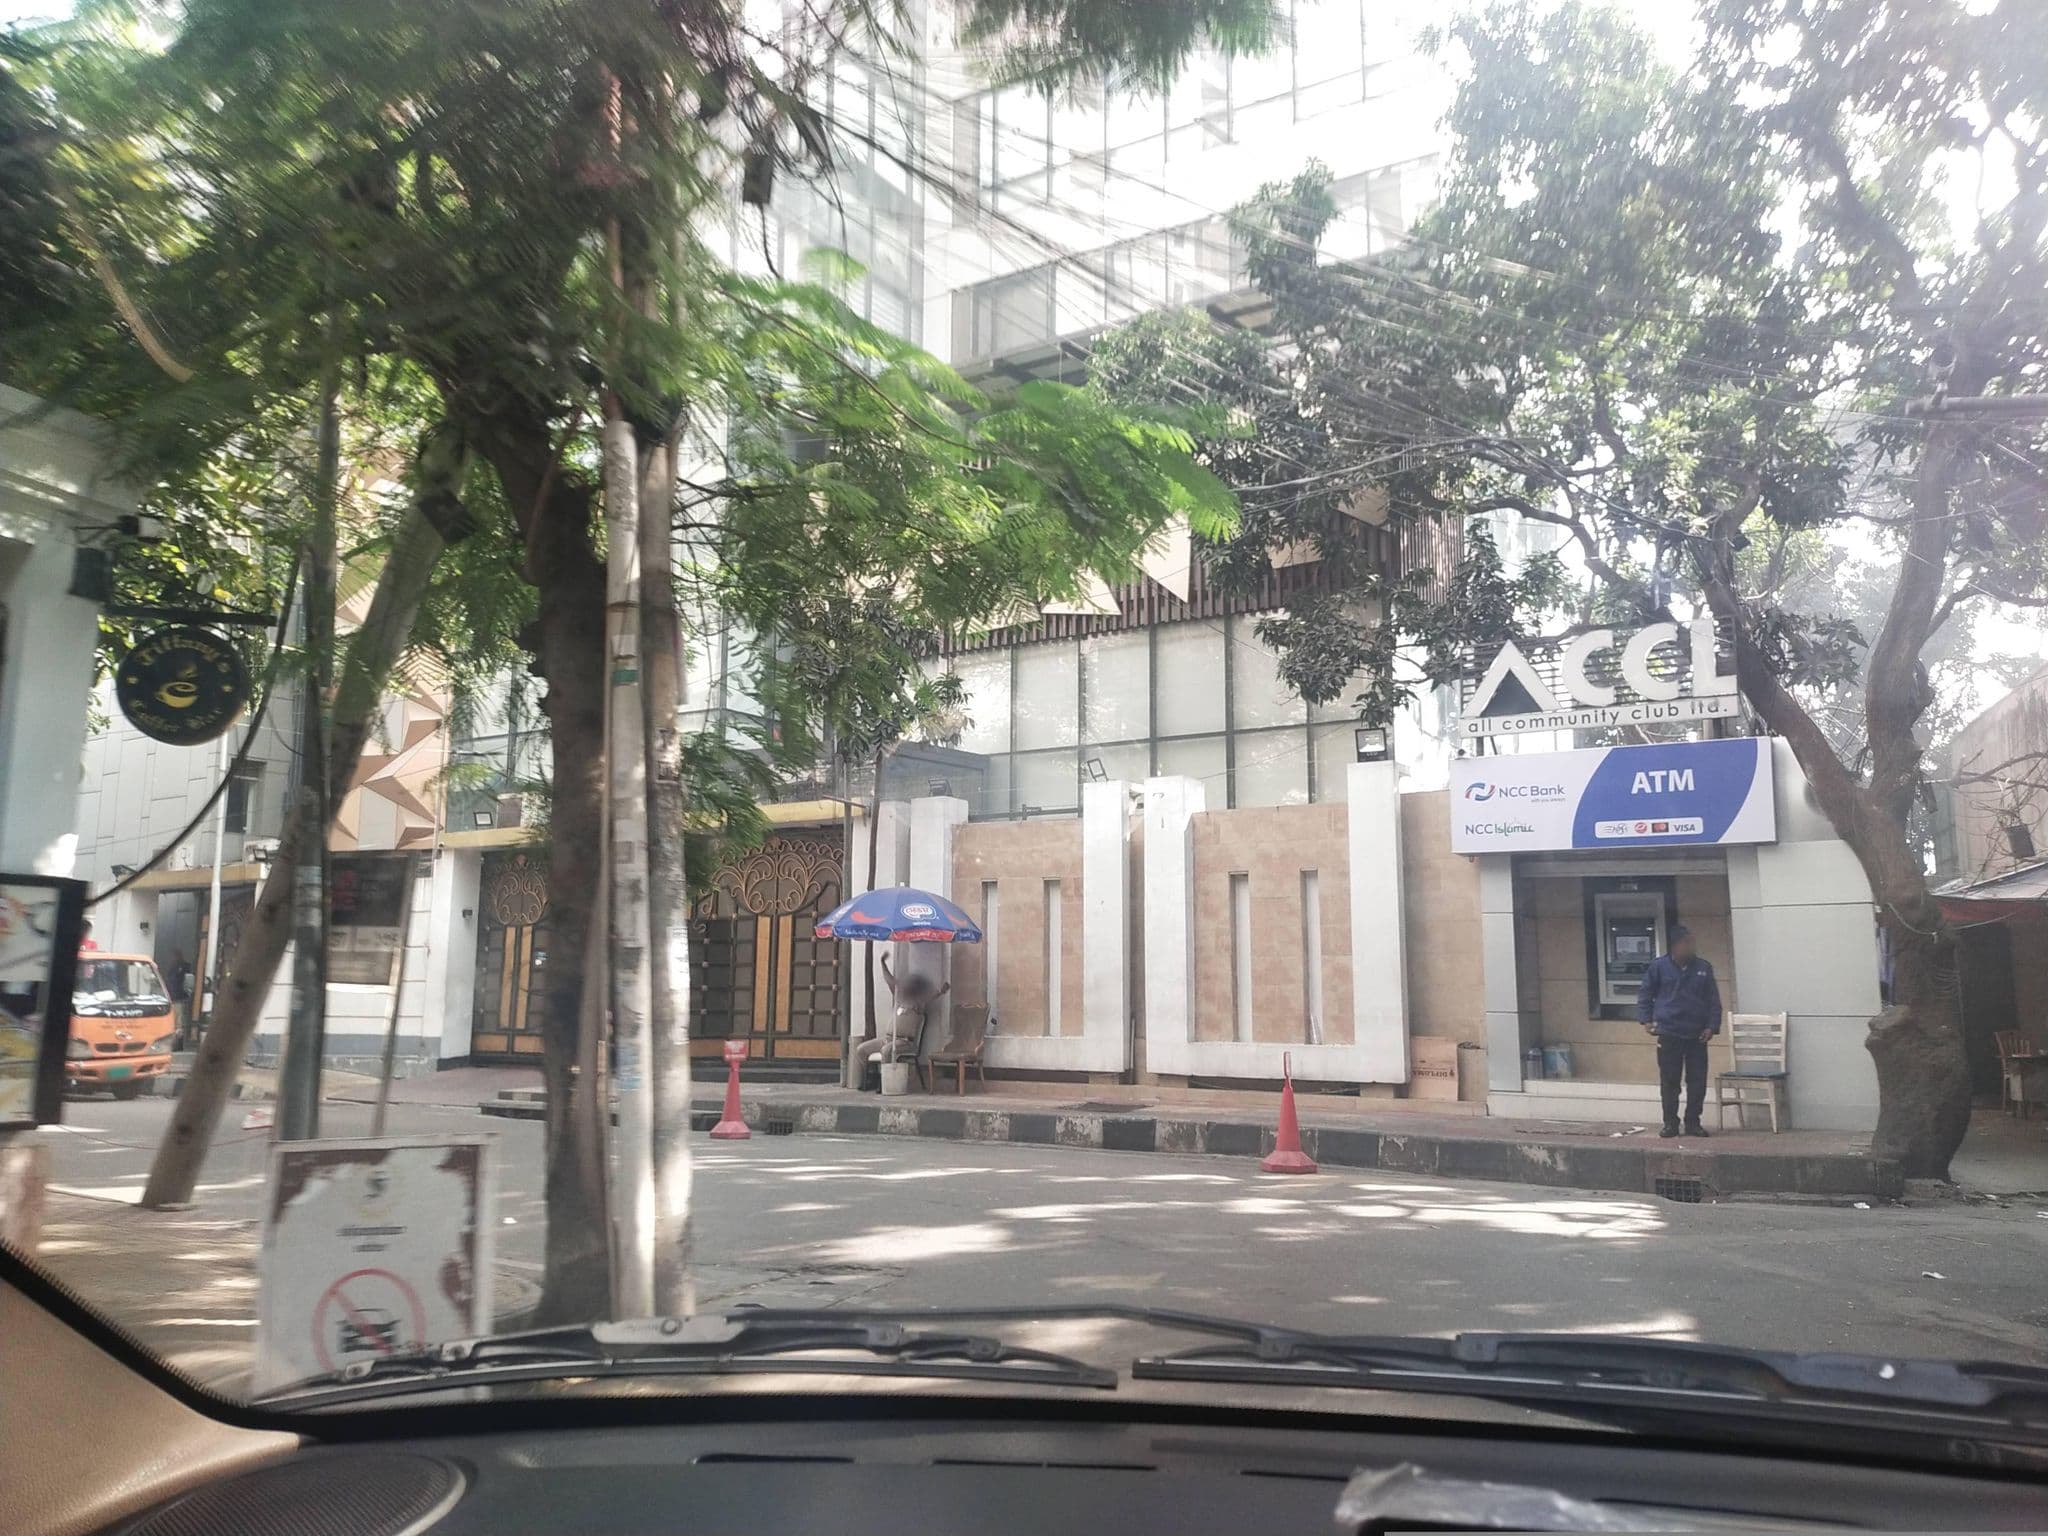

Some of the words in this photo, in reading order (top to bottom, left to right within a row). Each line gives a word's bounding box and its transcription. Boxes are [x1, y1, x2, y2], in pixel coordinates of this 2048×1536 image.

[1461, 618, 1738, 717] ACCL
[1468, 719, 1492, 733] all
[1501, 710, 1620, 732] community
[1631, 703, 1679, 720] club
[1498, 786, 1528, 798] NCC
[1530, 784, 1566, 797] Bank
[1631, 768, 1695, 795] ATM
[1465, 823, 1494, 836] NCC
[1673, 823, 1696, 833] VISA
